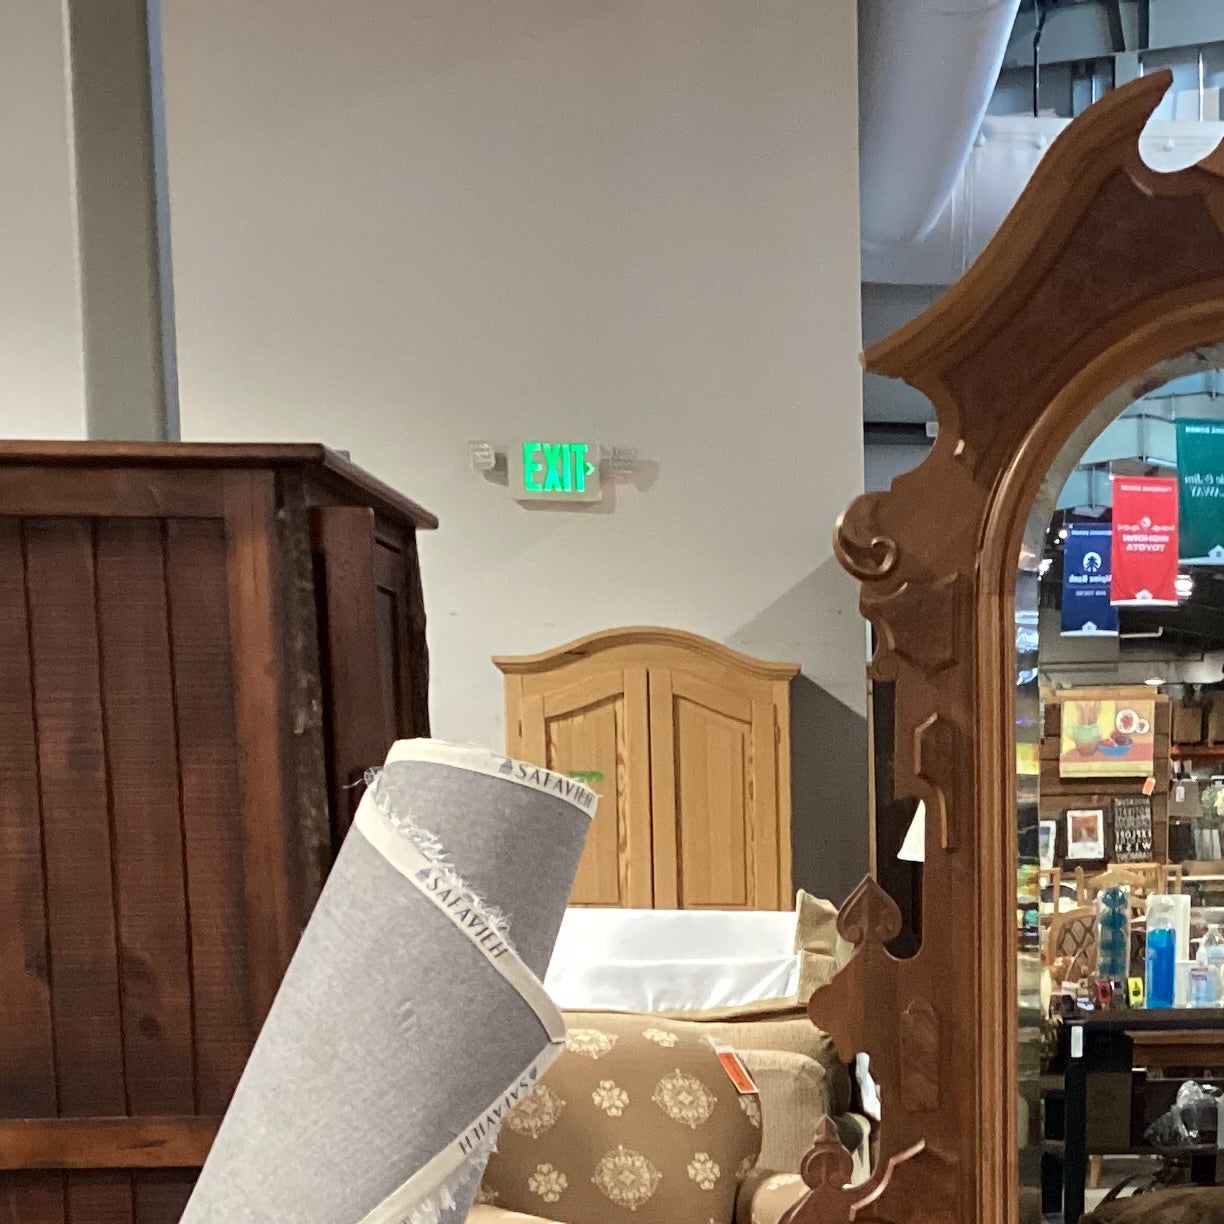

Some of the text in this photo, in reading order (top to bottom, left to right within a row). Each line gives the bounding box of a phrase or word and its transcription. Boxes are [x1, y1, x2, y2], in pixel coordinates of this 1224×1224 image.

[522, 441, 589, 493] EXIT
[515, 764, 595, 809] SAFAVIEH
[426, 875, 509, 958] SAFAVIEH
